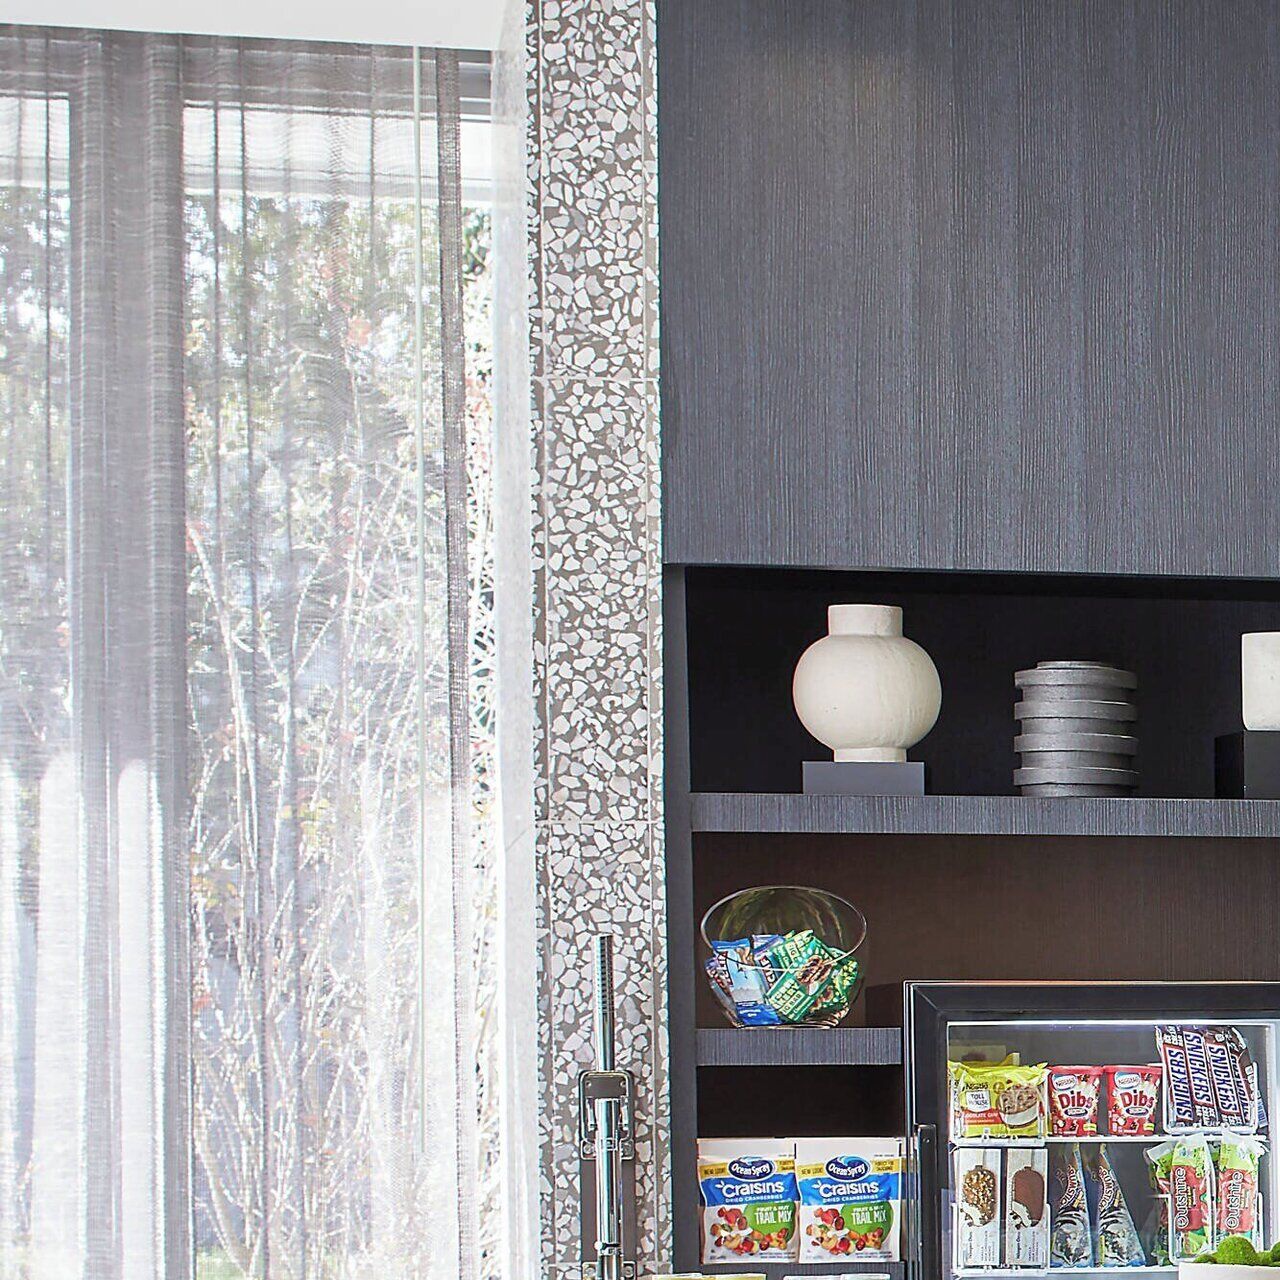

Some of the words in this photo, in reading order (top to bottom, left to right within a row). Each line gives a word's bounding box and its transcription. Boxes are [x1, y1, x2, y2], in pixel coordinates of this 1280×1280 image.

[1185, 1034, 1213, 1104] SNICKERS
[1167, 1050, 1193, 1120] SNICKERS
[1209, 1046, 1238, 1112] SNICKERS
[1058, 1091, 1094, 1109] Dibs
[1120, 1091, 1154, 1108] Dibs
[755, 1211, 775, 1225] TRAIL
[778, 1209, 793, 1222] MIX
[851, 1211, 871, 1225] TRAIL
[873, 1210, 887, 1222] MIX
